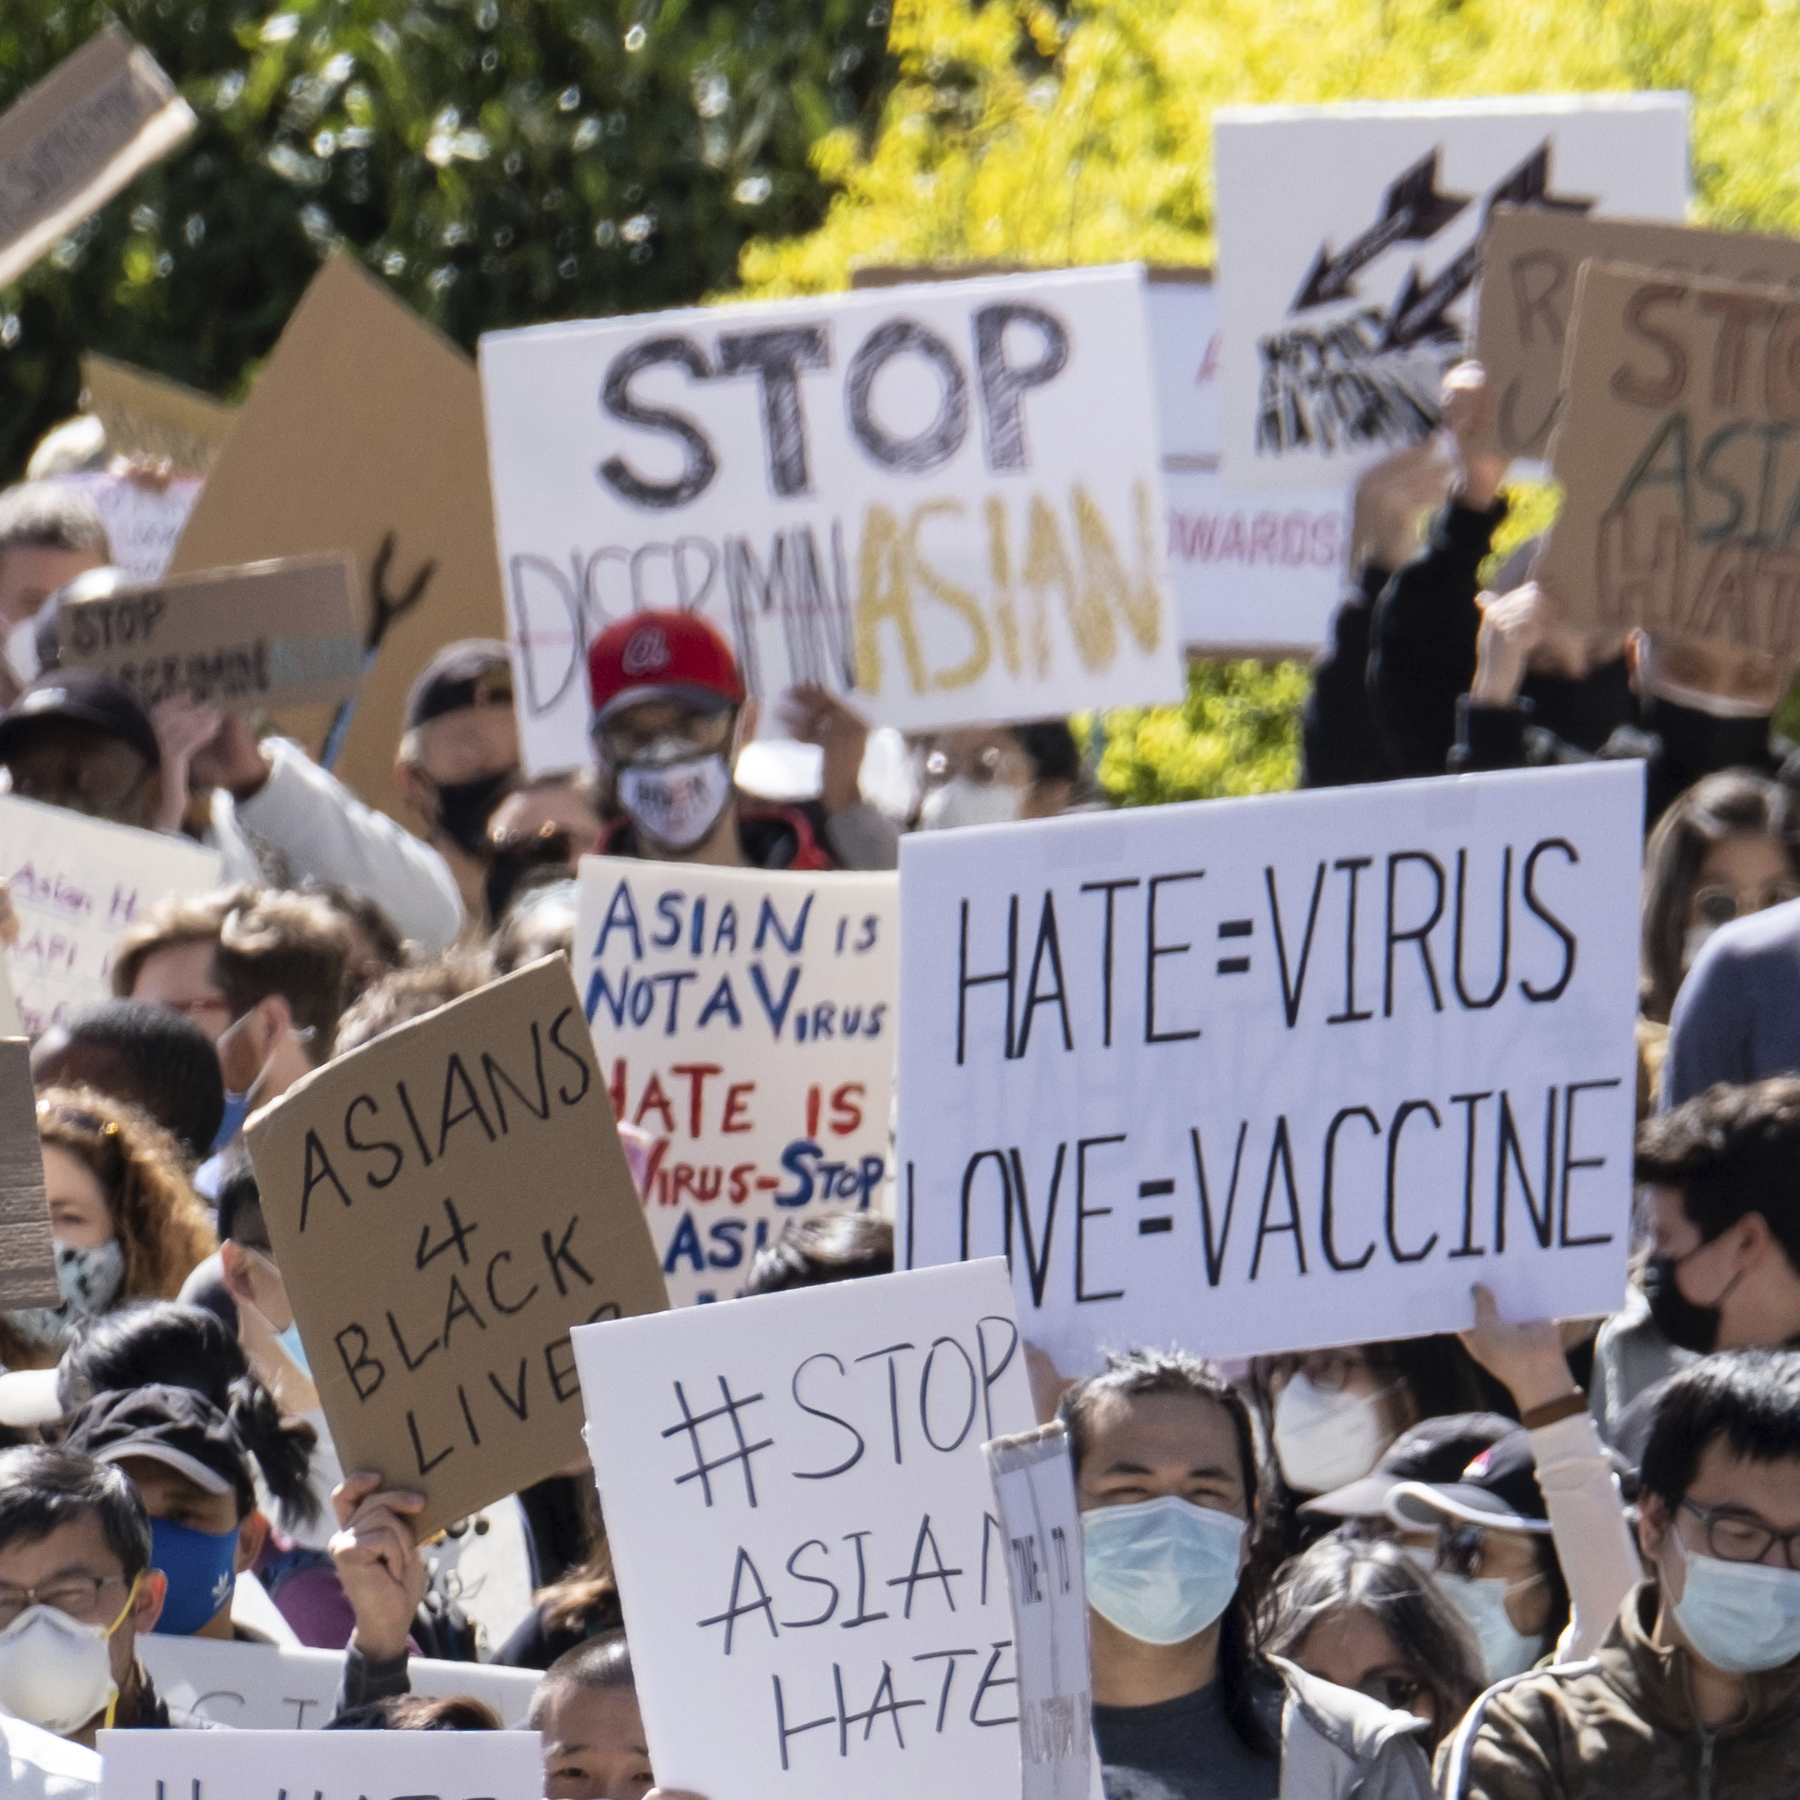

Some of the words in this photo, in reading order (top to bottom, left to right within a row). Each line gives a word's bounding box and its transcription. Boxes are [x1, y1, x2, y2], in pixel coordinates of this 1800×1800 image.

[597, 303, 1071, 509] STOP
[584, 963, 697, 1037] NOT
[696, 973, 744, 1028] A
[748, 962, 890, 1043] VIRUS
[592, 878, 818, 963] ASIAN
[834, 911, 881, 955] IS
[956, 837, 1581, 1067] HATE=VIRUS
[298, 1006, 592, 1234] ASIANS
[805, 1082, 867, 1138] IS
[904, 1077, 1623, 1309] LOVE=VACCINE
[334, 1214, 597, 1403] BLACK
[414, 1198, 479, 1271] 4
[405, 1302, 623, 1477] LIVE
[660, 1314, 1020, 1509] #STOP
[771, 1640, 1020, 1771] HATE
